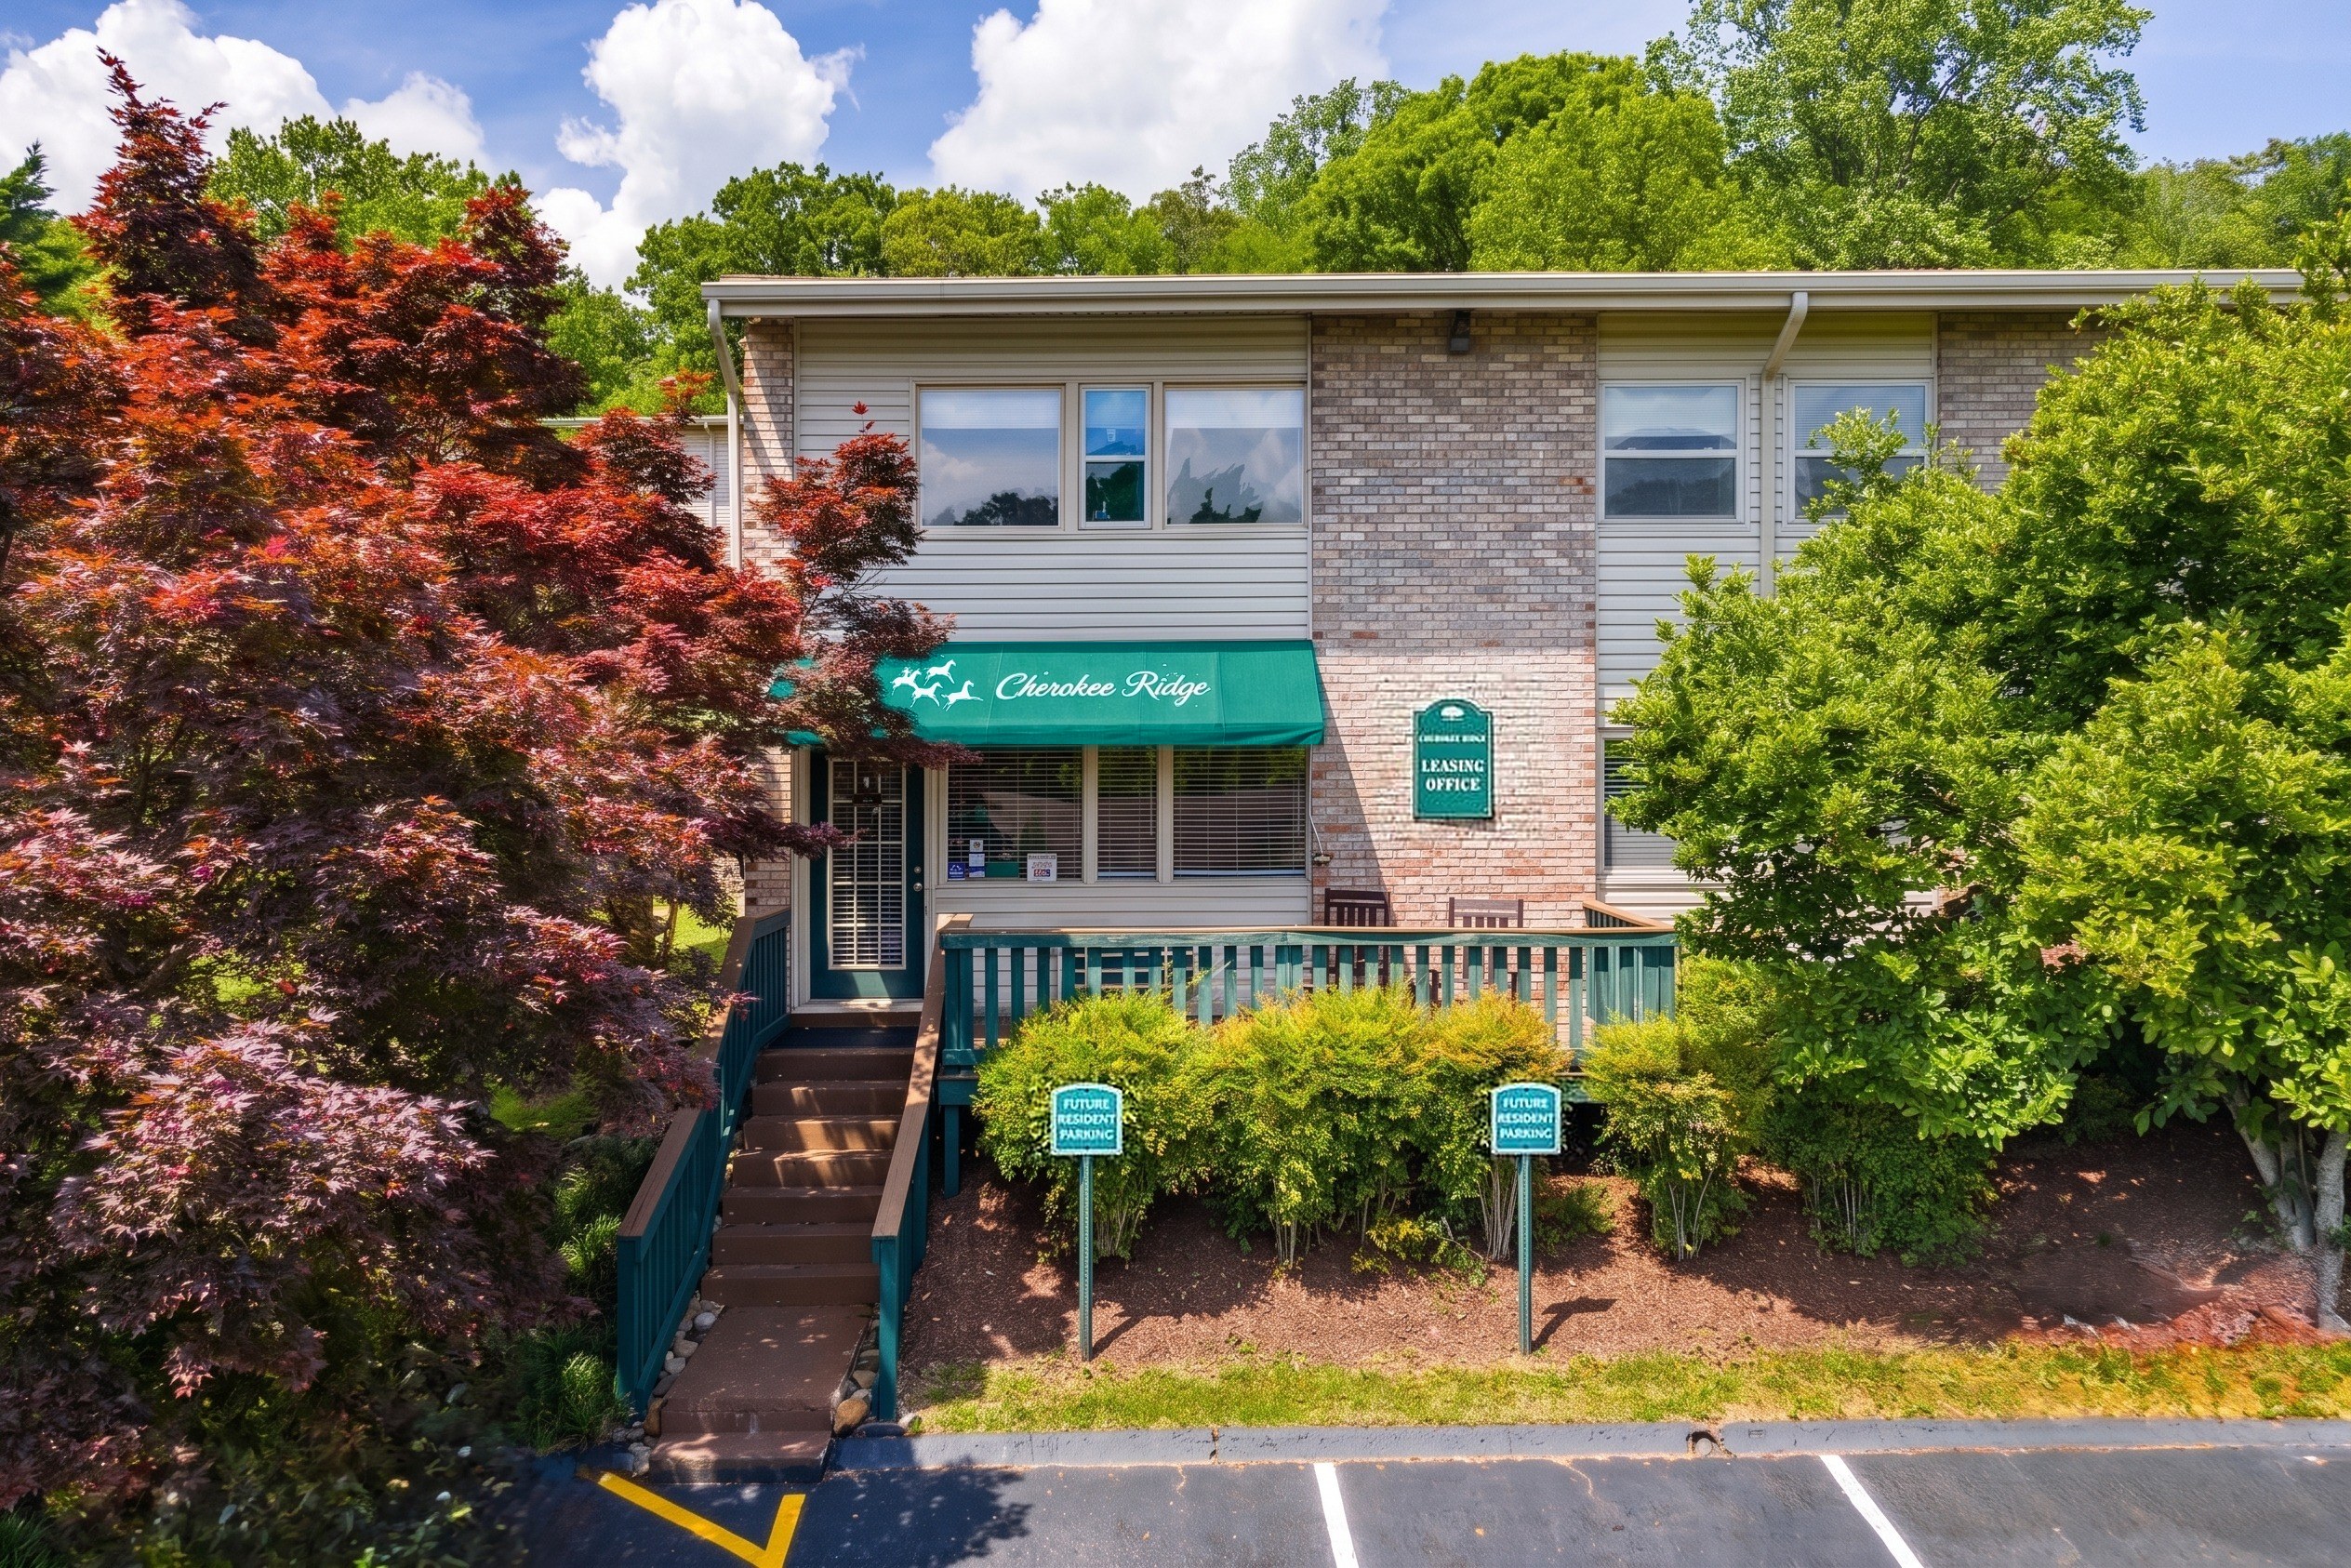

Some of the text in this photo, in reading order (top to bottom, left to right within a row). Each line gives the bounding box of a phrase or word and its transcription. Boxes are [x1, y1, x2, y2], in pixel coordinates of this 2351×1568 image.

[995, 671, 1211, 707] Cherokee Ridge
[1422, 759, 1484, 773] LEASING
[1426, 777, 1481, 791] OFFICE
[1063, 1098, 1110, 1110] FUTURE
[1503, 1097, 1548, 1109] FUTURE
[1057, 1113, 1115, 1124] RESIDENT
[1059, 1129, 1114, 1140] PARKING
[1499, 1127, 1552, 1139] PARKING
